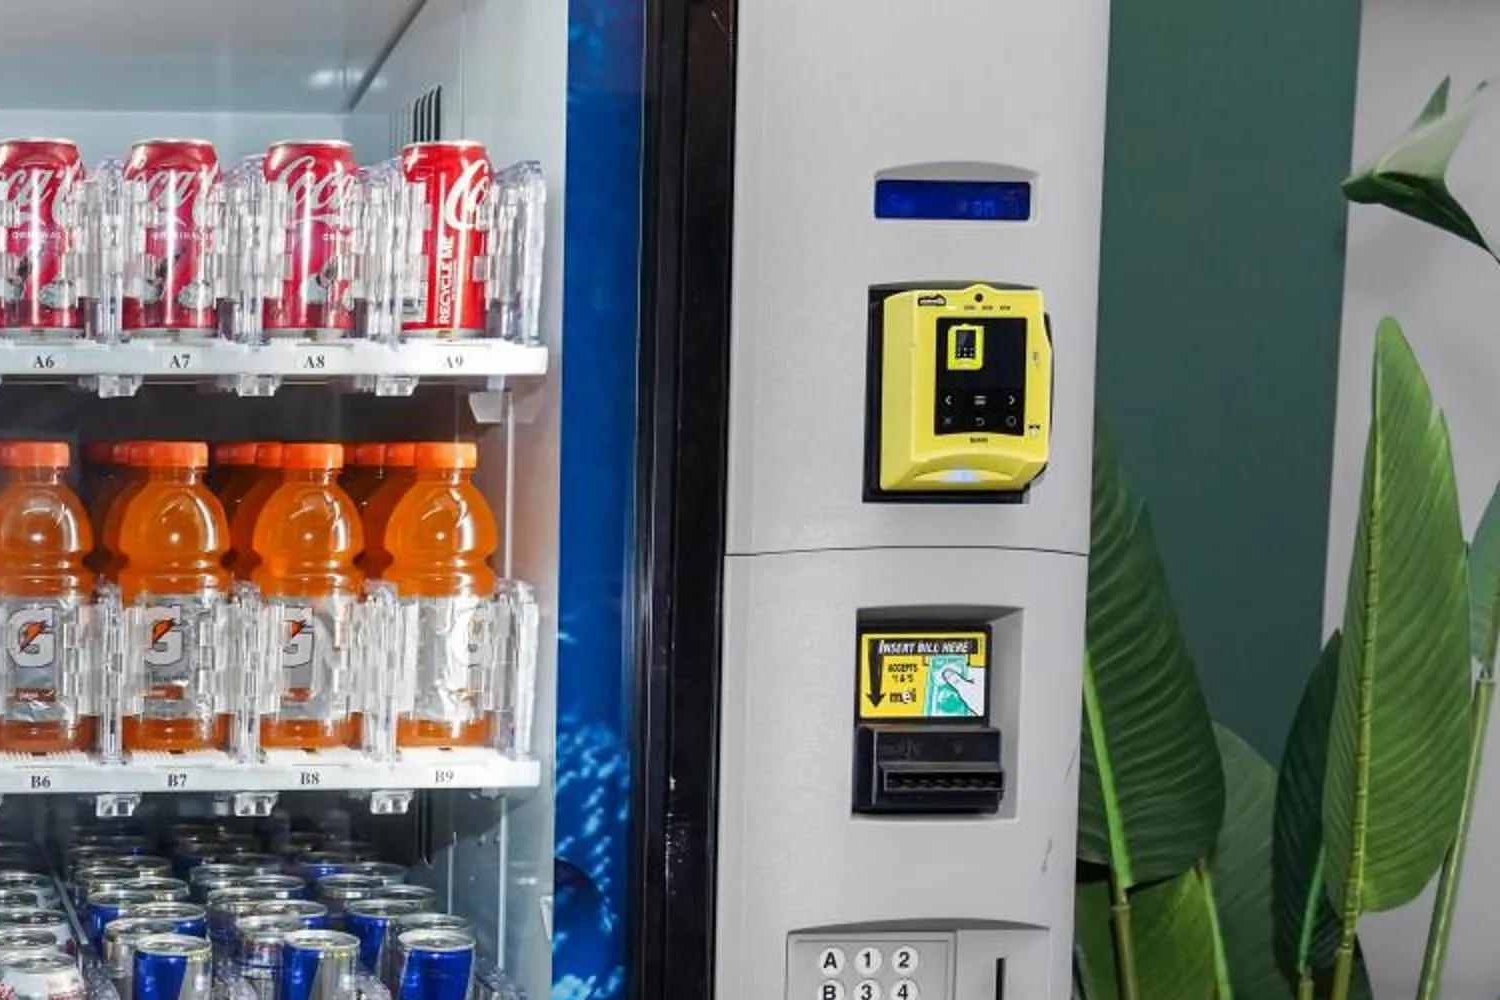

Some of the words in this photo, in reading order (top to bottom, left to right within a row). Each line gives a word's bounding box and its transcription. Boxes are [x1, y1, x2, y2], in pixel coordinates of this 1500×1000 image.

[34, 355, 55, 369] A6
[170, 353, 191, 369] A7
[305, 355, 325, 369] A8
[444, 355, 464, 369] A9
[6, 605, 56, 668] G
[879, 640, 915, 653] INSERT
[941, 641, 970, 653] HERE
[31, 775, 51, 789] B6
[167, 773, 187, 788] B7
[300, 772, 320, 786] B8
[435, 770, 455, 784] B9
[824, 952, 837, 968] A
[864, 952, 870, 967] 1
[899, 952, 909, 968] 2
[823, 985, 836, 1000] B
[862, 984, 871, 1000] 3
[898, 984, 908, 1000] 4
